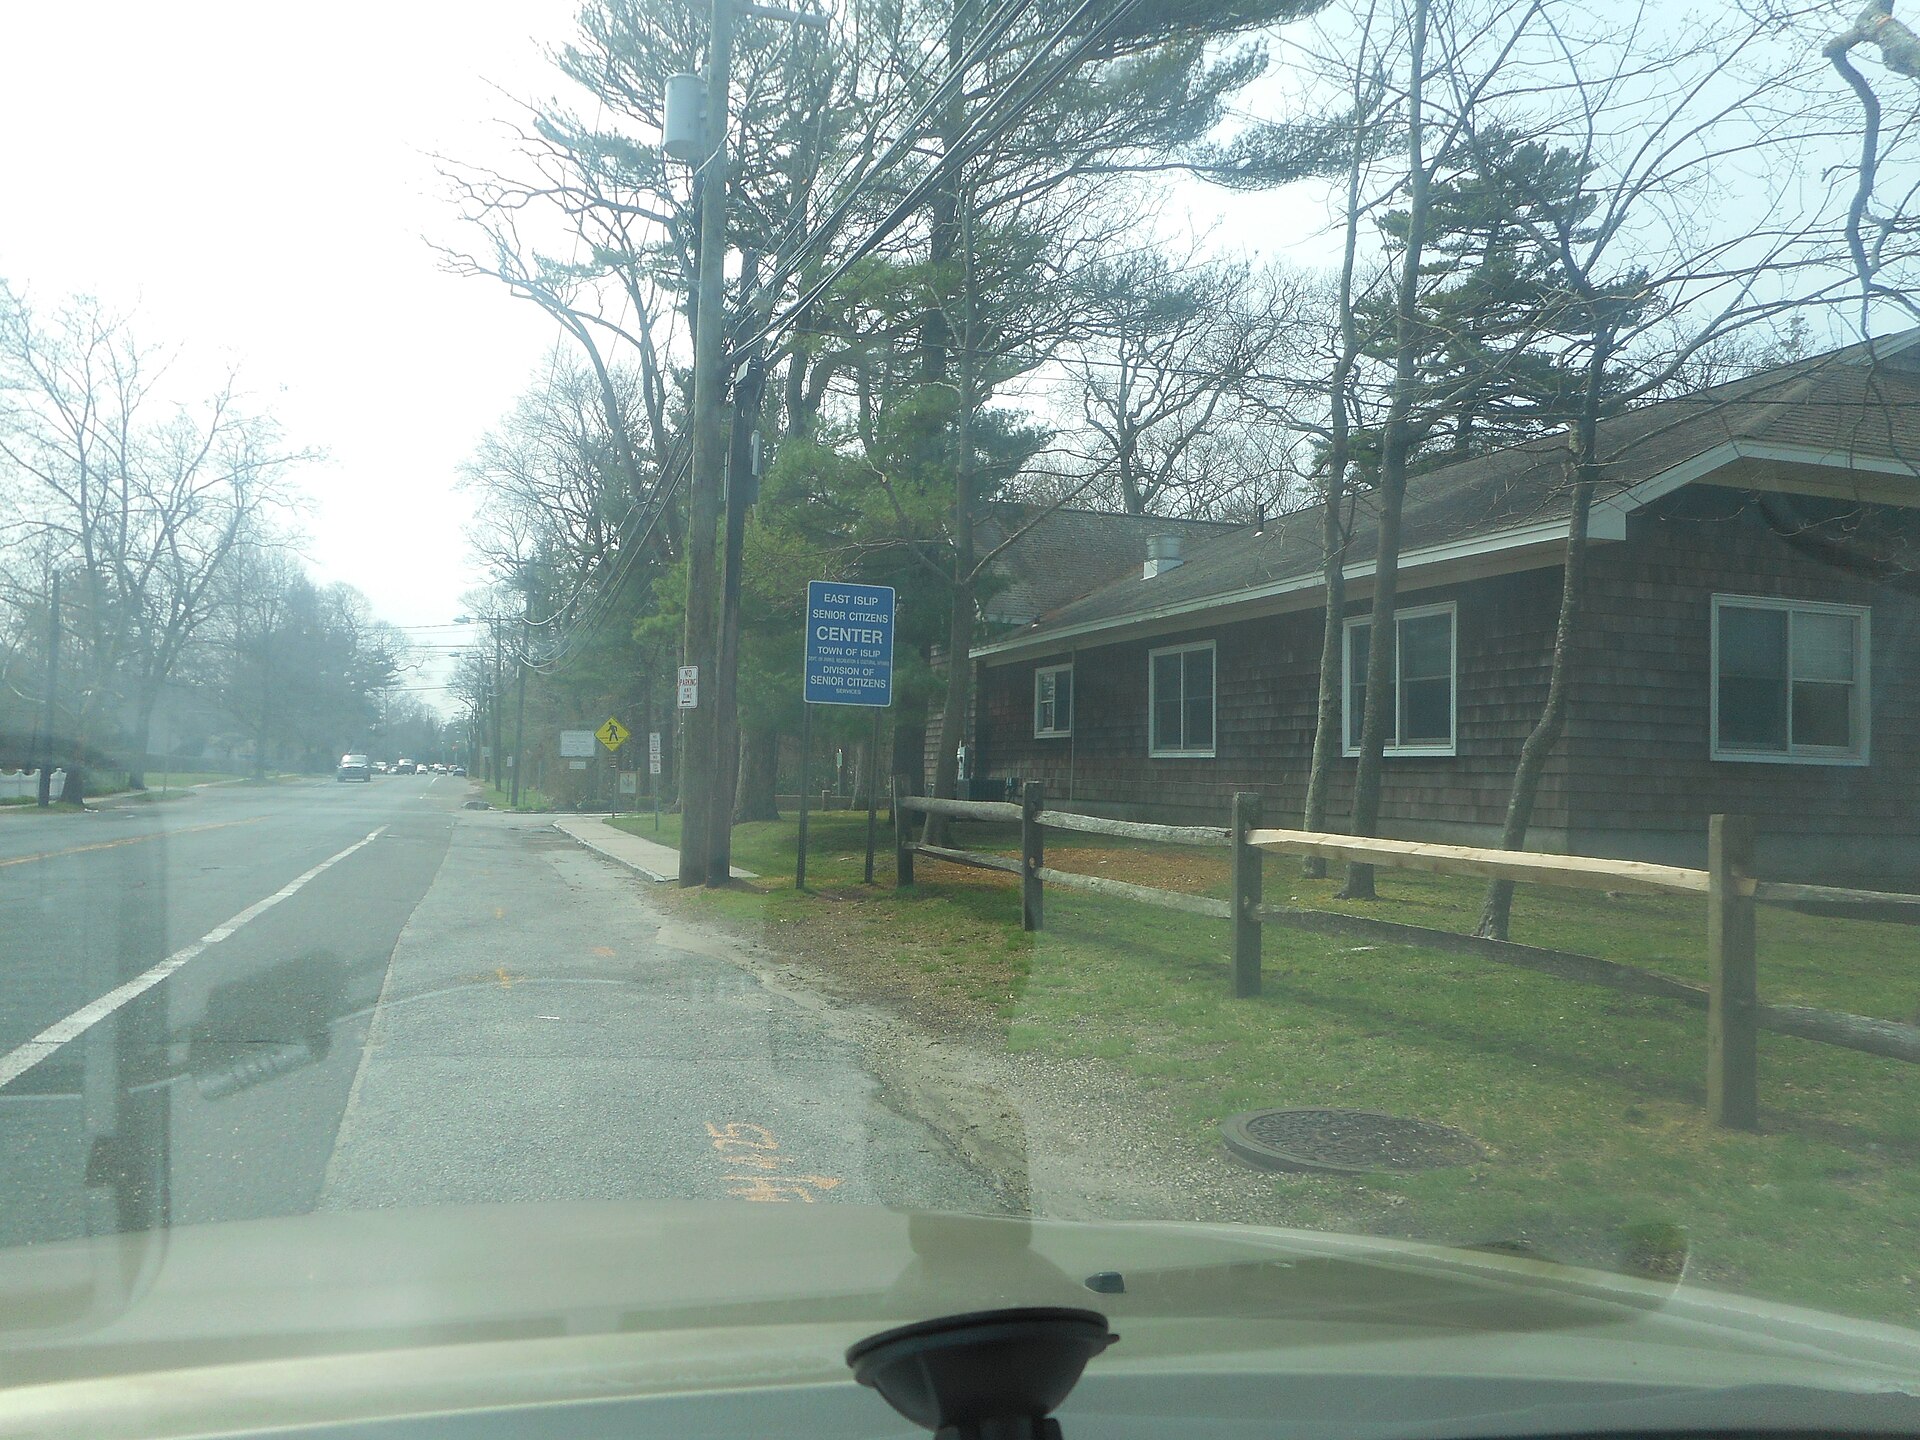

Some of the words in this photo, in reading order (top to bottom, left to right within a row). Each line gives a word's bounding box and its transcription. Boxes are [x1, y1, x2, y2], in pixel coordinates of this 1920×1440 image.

[824, 593, 850, 604] EAST
[854, 596, 879, 606] ISLIP
[812, 609, 846, 620] SENIOR
[849, 612, 889, 624] CITIZENS
[816, 626, 883, 644] CENTER
[818, 646, 843, 655] TOWN
[845, 648, 858, 656] OF
[860, 649, 881, 658] ISLIP
[823, 665, 860, 675] DIVISION
[862, 668, 874, 676] OF
[810, 675, 844, 686] SENIOR
[847, 677, 886, 688] CITIZENS
